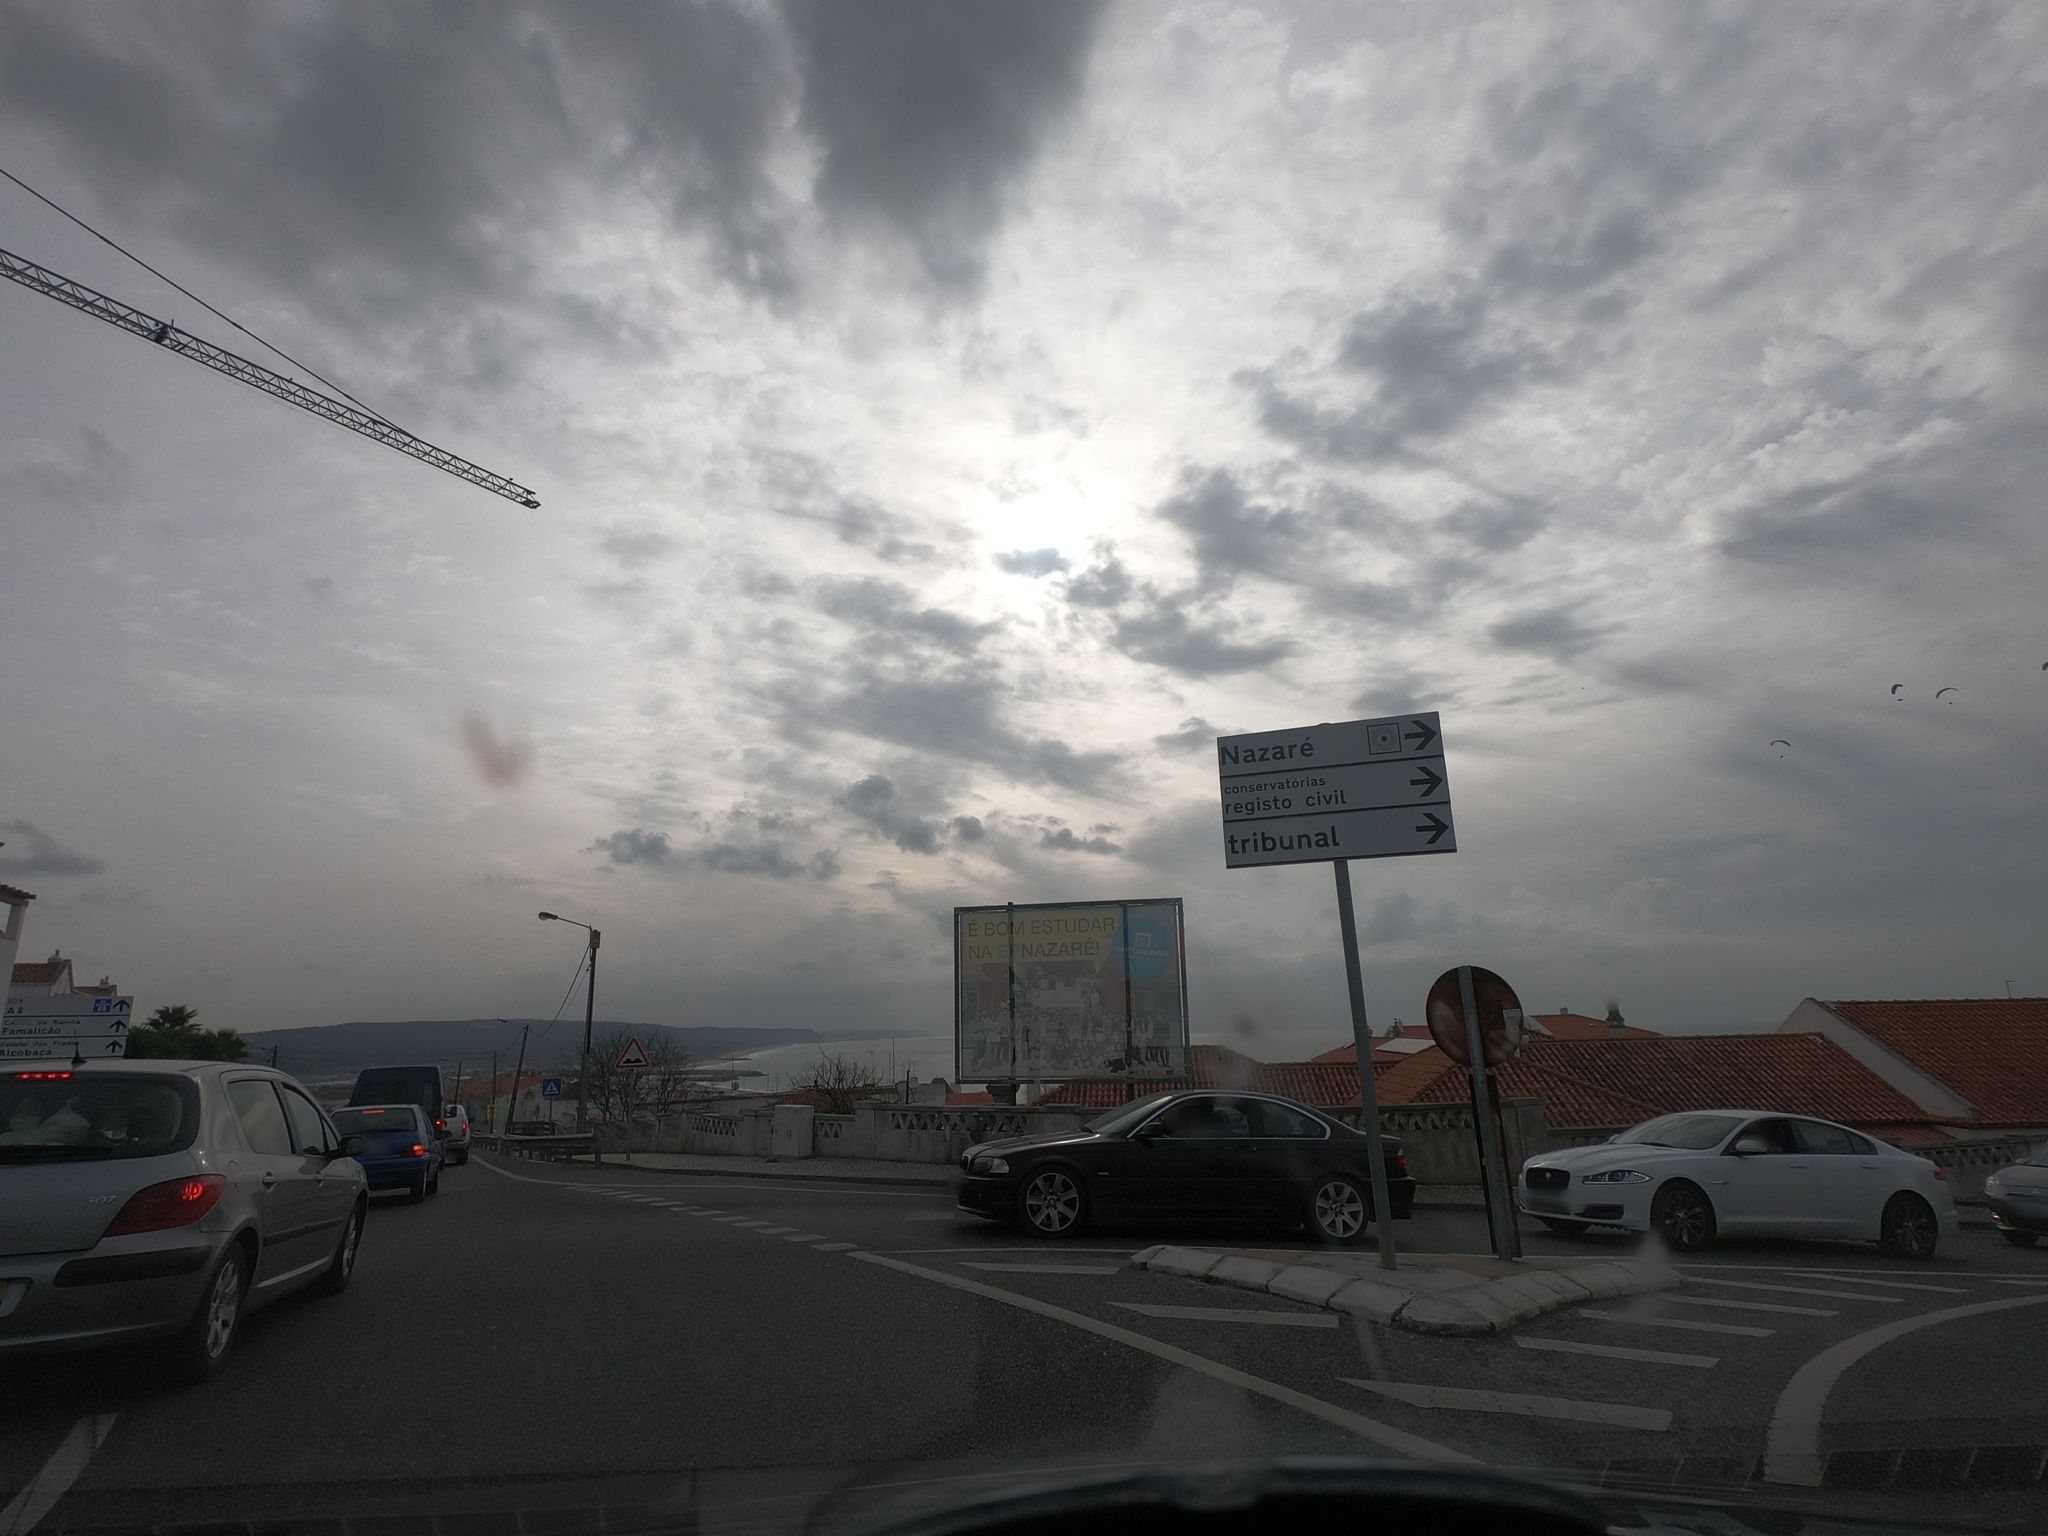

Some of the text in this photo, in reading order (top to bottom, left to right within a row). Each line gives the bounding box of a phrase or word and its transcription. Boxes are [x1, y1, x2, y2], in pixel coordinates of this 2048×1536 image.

[1220, 736, 1314, 766] Nazaré
[1224, 775, 1326, 795] conservatórias
[1225, 790, 1347, 816] registo civil
[1228, 826, 1340, 855] tribunal
[968, 917, 1115, 937] É BOM ESTUDAR
[968, 944, 993, 959] NA
[1021, 937, 1100, 958] NAZARÉ!
[2, 1027, 61, 1035] Famalicão
[0, 1049, 52, 1057] Alcobaça
